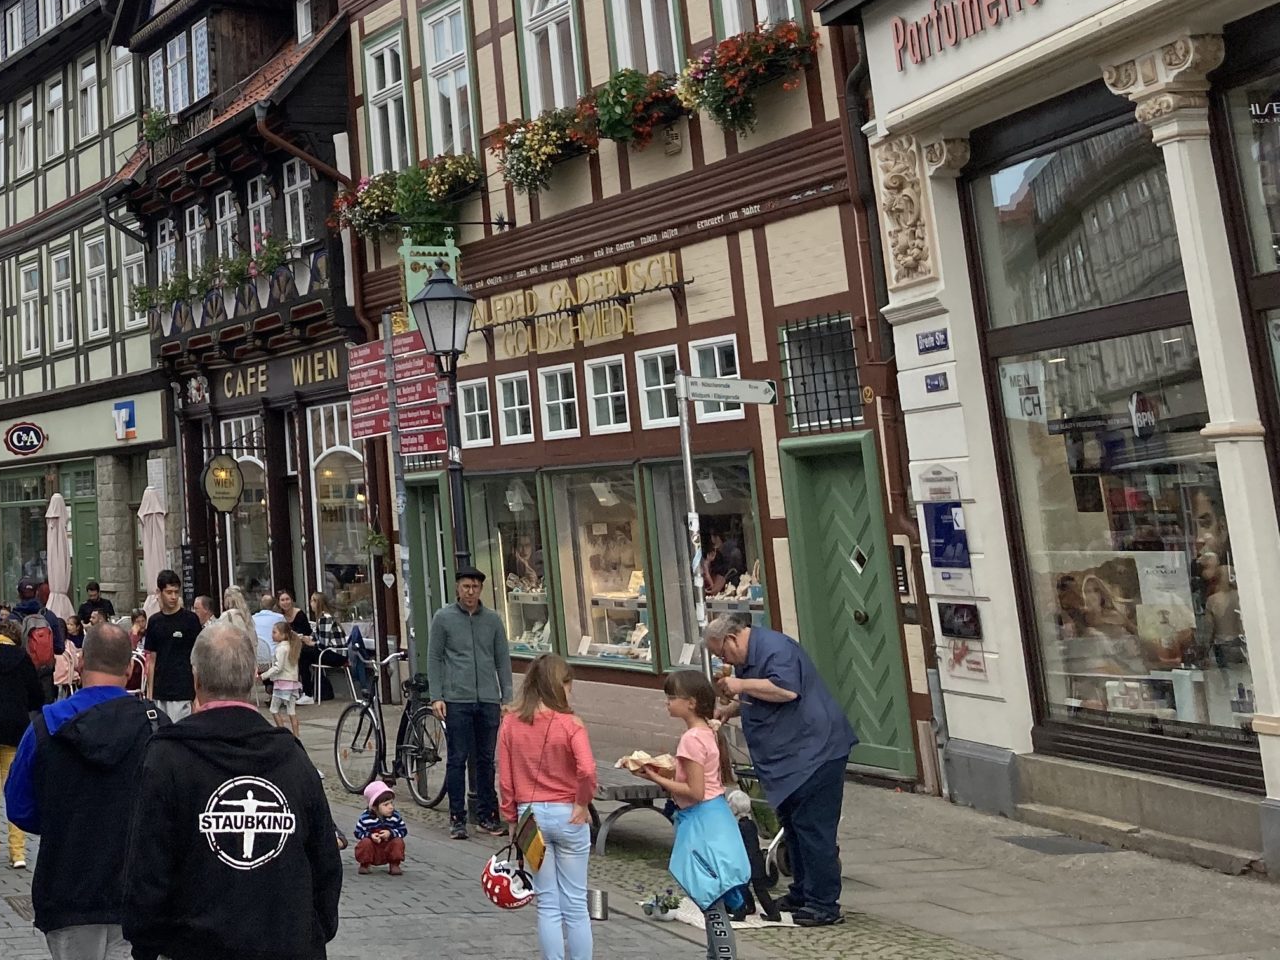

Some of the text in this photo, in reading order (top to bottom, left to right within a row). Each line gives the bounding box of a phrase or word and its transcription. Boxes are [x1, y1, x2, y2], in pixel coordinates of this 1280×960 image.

[471, 289, 538, 330] ALFRED
[503, 303, 636, 358] GOLDSCHMIEDE
[224, 348, 339, 399] CAFE WIEN
[1008, 372, 1031, 388] MEIN
[1020, 395, 1043, 417] ICH
[12, 430, 39, 447] C&A
[214, 478, 235, 489] WIEN
[200, 814, 294, 830] STAUBKIND
